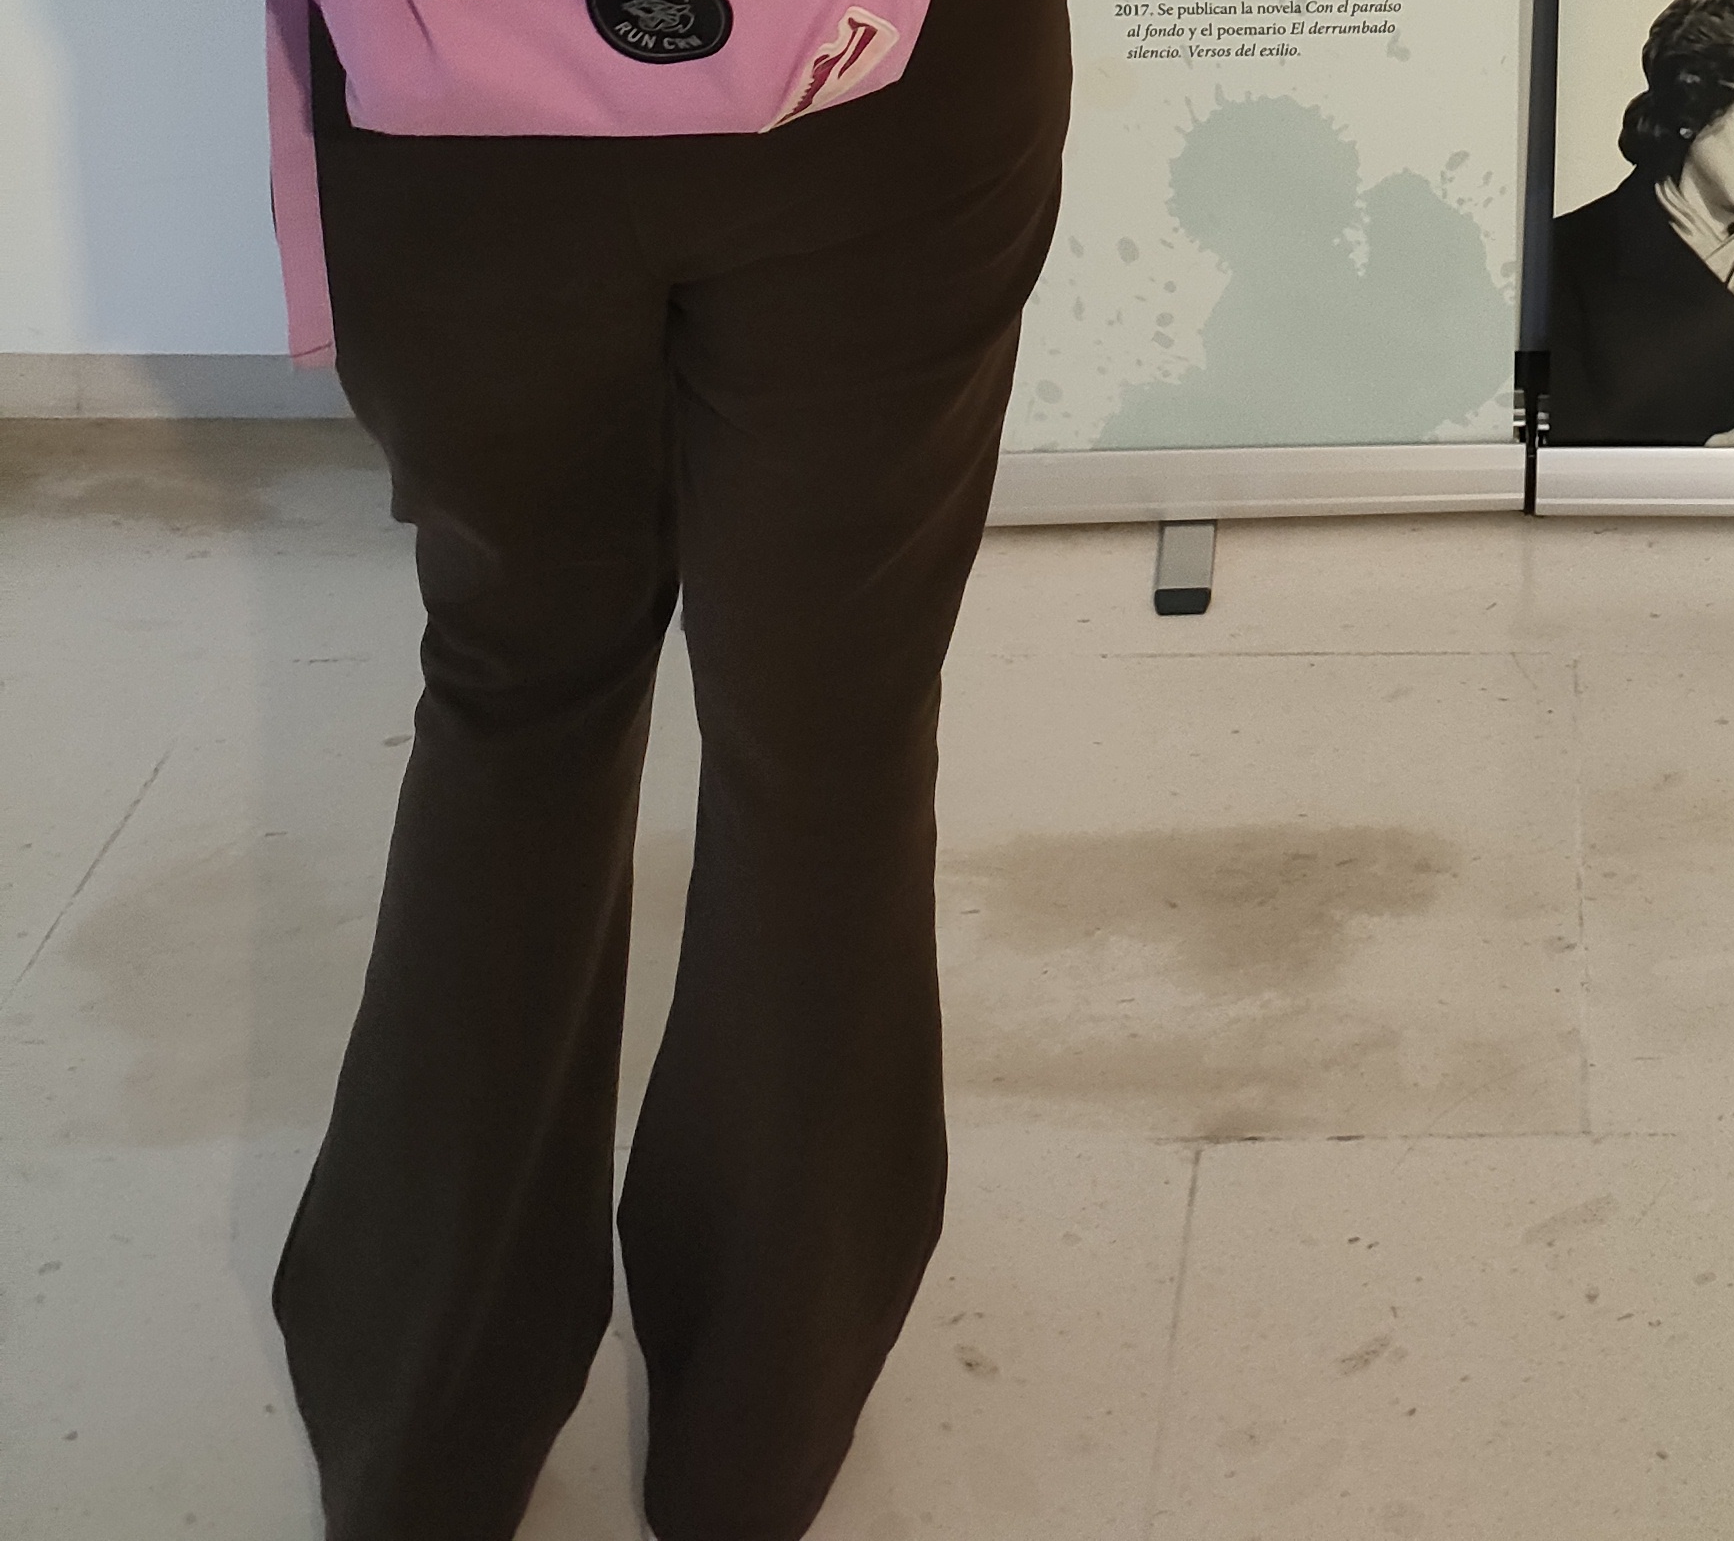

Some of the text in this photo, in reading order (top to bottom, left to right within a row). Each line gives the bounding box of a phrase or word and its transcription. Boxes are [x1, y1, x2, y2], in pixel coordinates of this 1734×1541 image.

[1114, 0, 1402, 20] 2017. Se publican la novela Con el paraíso
[614, 21, 657, 49] RUN
